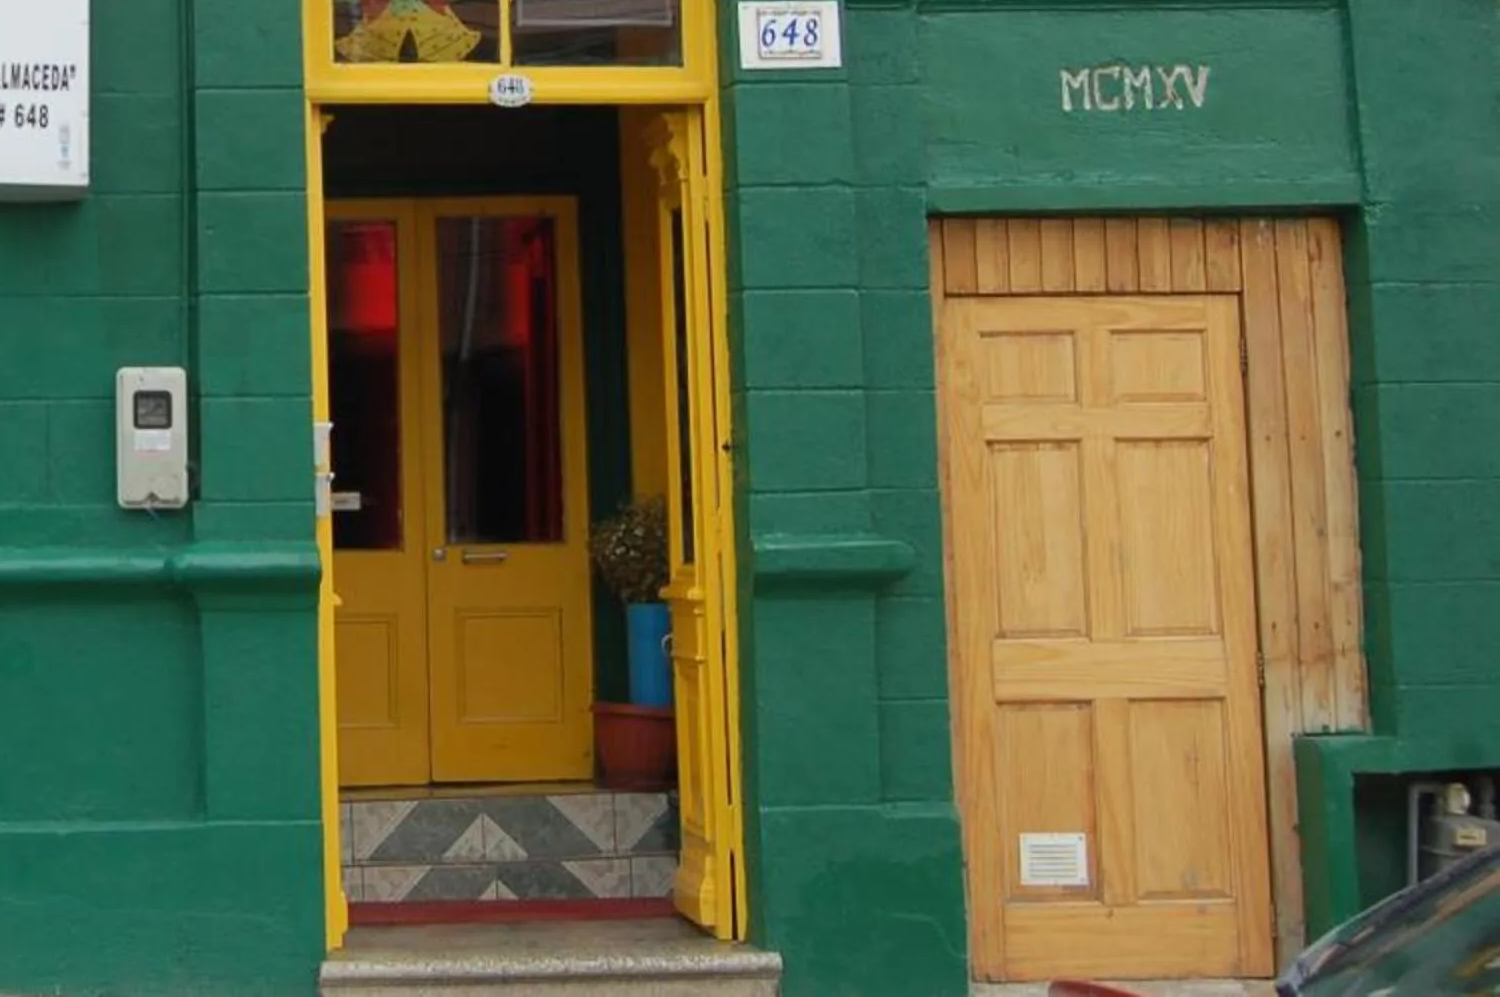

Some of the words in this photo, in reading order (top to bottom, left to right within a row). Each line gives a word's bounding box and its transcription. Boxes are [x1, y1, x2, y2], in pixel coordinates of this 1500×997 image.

[760, 19, 819, 47] 648
[1059, 66, 1211, 111] MCMXV
[14, 104, 49, 129] 648
